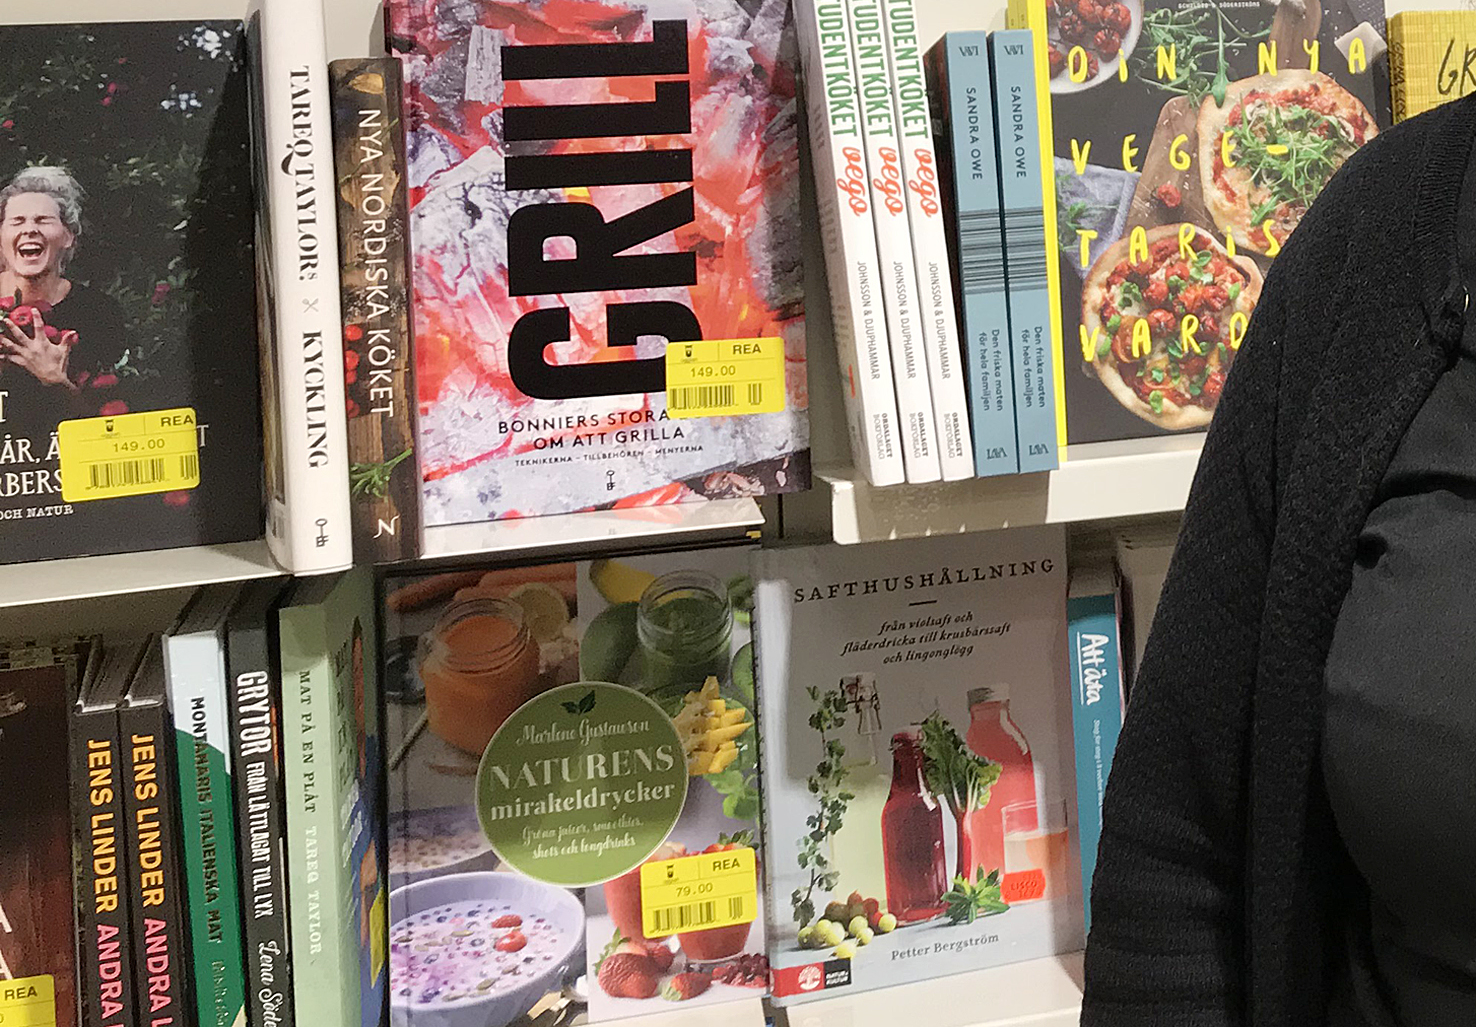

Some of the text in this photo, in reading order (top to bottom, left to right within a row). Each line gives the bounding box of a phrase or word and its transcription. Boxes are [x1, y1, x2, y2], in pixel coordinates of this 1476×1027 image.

[1258, 38, 1367, 78] NYA
[966, 86, 983, 179] SANDRA OWE
[1011, 86, 1027, 178] SANDRA OWE
[837, 146, 868, 217] vego
[873, 146, 904, 217] vego
[908, 148, 939, 218] vego
[501, 19, 704, 401] GRILL
[281, 65, 313, 175] TAREQ
[302, 330, 330, 469] KYCKLING
[358, 108, 396, 418] NYA NORDISKA KÖKET
[893, 261, 908, 307] JOHNSSON
[929, 261, 943, 307] JOHNSSON
[857, 261, 873, 307] JOHNSSON
[865, 319, 881, 380] DJUPHAMMAR
[691, 365, 736, 377] 149.00
[732, 343, 762, 355] REA
[900, 319, 916, 379] DJUPHAMMAR
[935, 319, 951, 379] DJUPHAMMAR
[978, 332, 991, 411] för hela familjen
[991, 329, 1004, 411] Den friska maten
[1022, 329, 1034, 408] för hela familjen
[1034, 326, 1047, 408] Den friska maten
[160, 415, 194, 427] REA
[499, 410, 670, 434] BONNIERS STORA
[534, 426, 685, 450] OM ATT GRILLA
[113, 439, 165, 453] 149.00
[515, 445, 704, 467] TEKNIKERNA TILLBEHÖREN MENYERNA
[27, 504, 74, 519] NATUR
[794, 558, 1055, 603] SAFTHUSHÅLLNING
[840, 623, 1011, 657] fläderdricka till krusbärssaft
[878, 611, 973, 636] från violsaft och
[883, 644, 974, 664] och lingonglögg
[1081, 633, 1110, 665] Att
[191, 697, 216, 802] MONTANARIS
[300, 670, 318, 814] MAT PÅ EN PLÅT
[489, 745, 675, 792] NATURENS
[237, 671, 274, 919] GRYTOR FRÅN LÄTTLAGAT TILL LYX
[490, 781, 676, 821] mirakeldrycker
[199, 809, 219, 903] ITALIENSKA
[580, 832, 636, 857] longdrinks
[713, 857, 741, 872] REA
[87, 739, 124, 1019] JENS LINDER ANDRA
[131, 734, 172, 1012] JENS LINDER ANDRA
[305, 825, 322, 955] TAREQ TAYLOR
[676, 882, 714, 897] 79.00
[206, 910, 223, 943] MAT
[891, 931, 1000, 961] Petter Bergström
[257, 940, 282, 985] Lena
[5, 986, 38, 1001] REA
